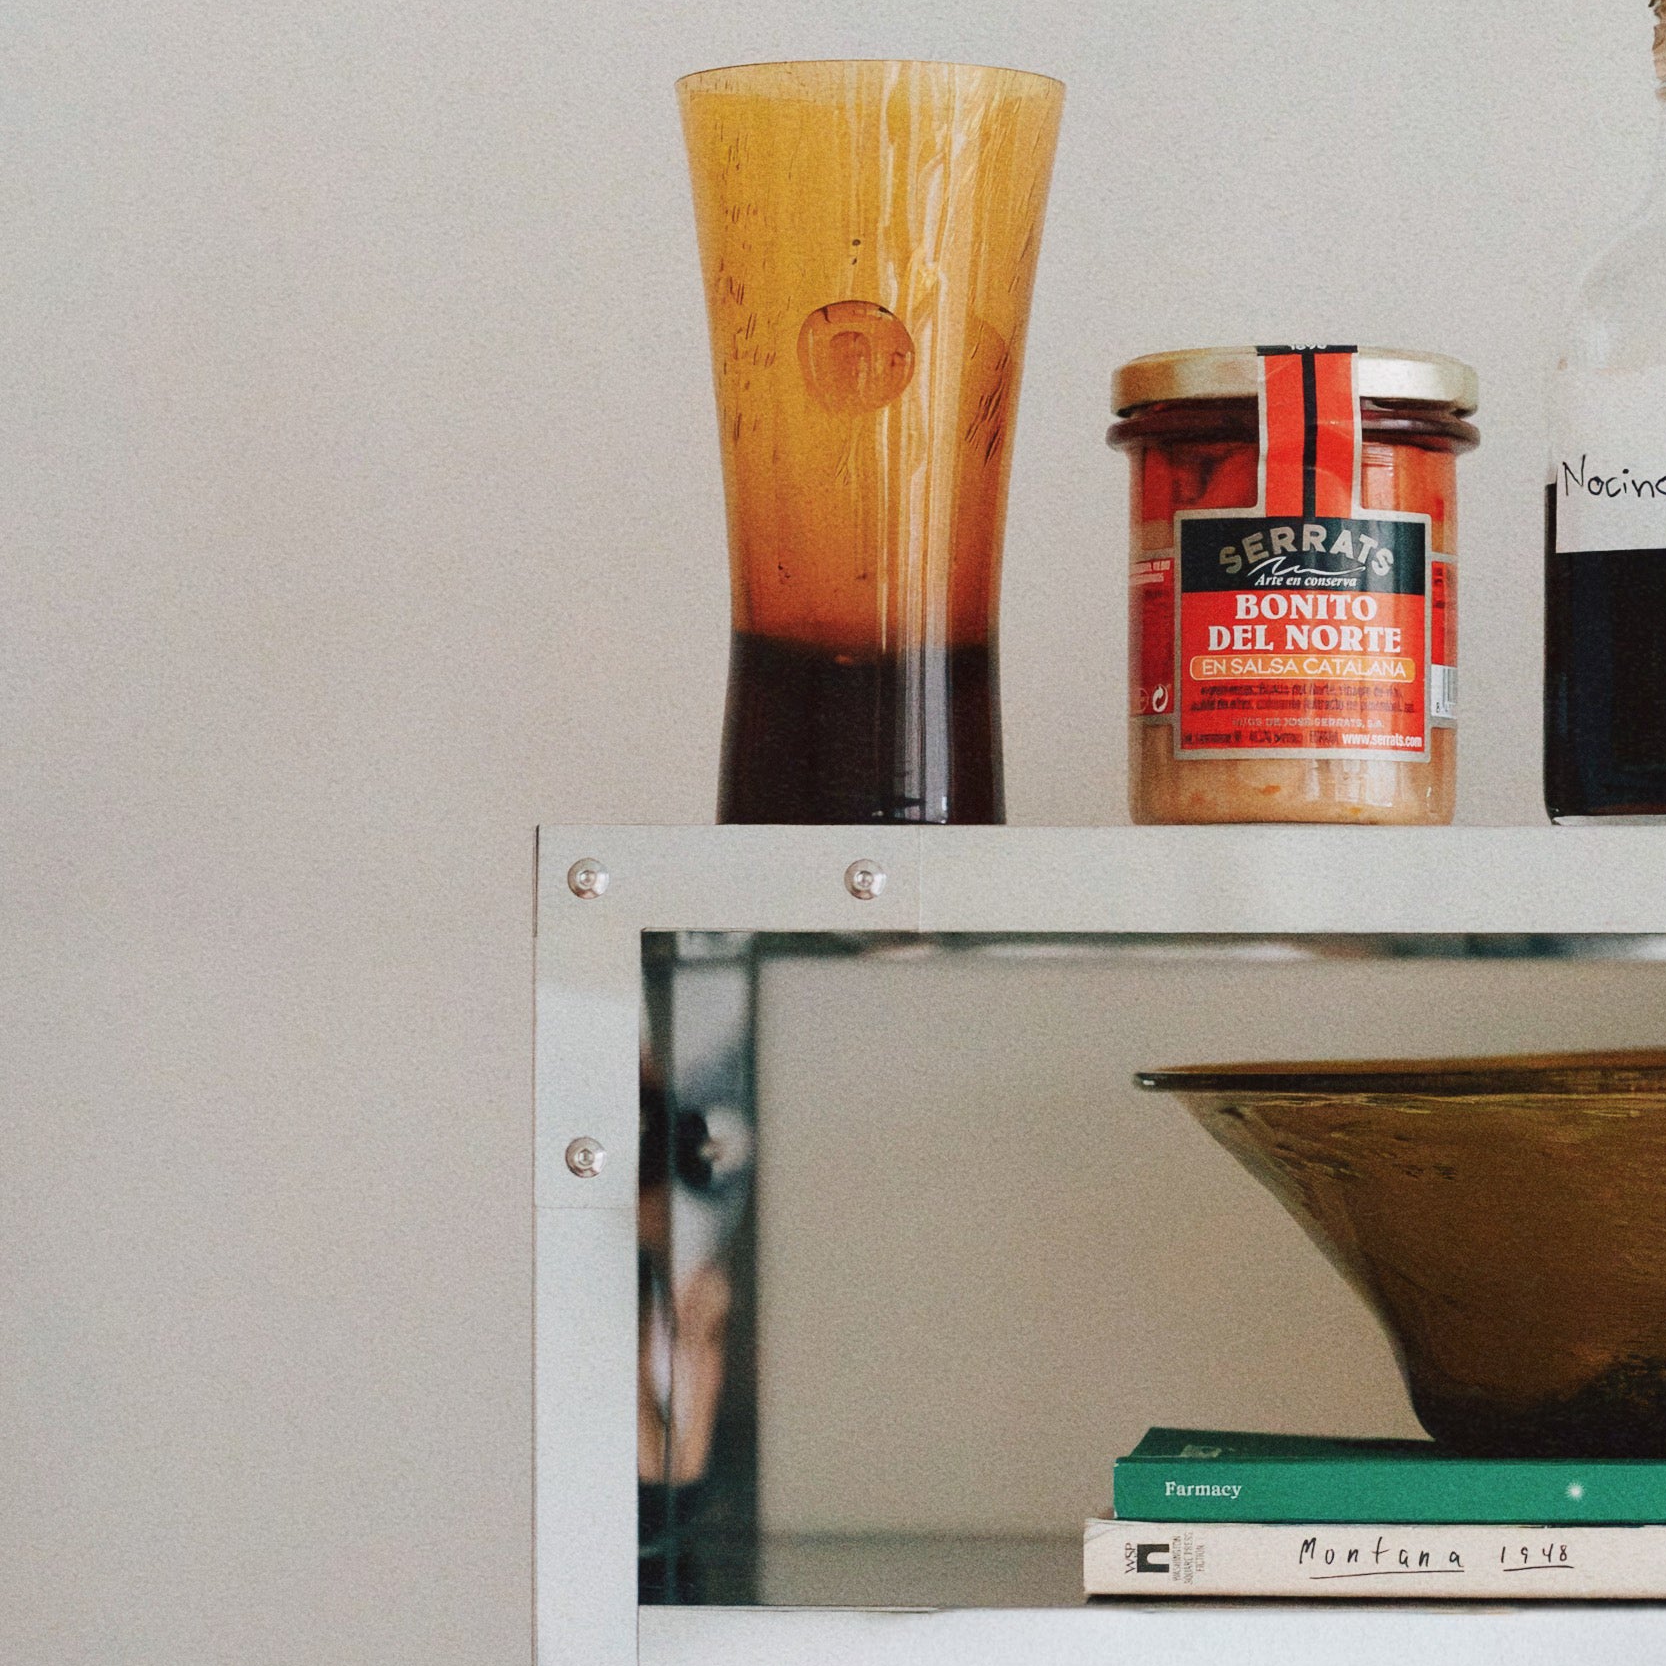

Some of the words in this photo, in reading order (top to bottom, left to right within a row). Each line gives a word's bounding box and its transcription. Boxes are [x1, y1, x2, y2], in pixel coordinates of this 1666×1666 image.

[1219, 524, 1394, 577] SERRATS
[1255, 575, 1283, 587] Arte
[1286, 577, 1302, 587] en
[1304, 577, 1358, 587] conserva
[1235, 594, 1378, 621] BONITO
[1208, 625, 1274, 651] DEL
[1285, 625, 1401, 653] NORTE
[1202, 659, 1227, 676] EN
[1230, 658, 1299, 676] SALSA
[1302, 658, 1407, 678] CATALANA
[1342, 733, 1423, 748] www.serrats.com
[1164, 1480, 1242, 1500] Farmacy
[1124, 1542, 1136, 1574] WSP
[1299, 1537, 1465, 1568] Montana
[1500, 1542, 1570, 1564] 1948
